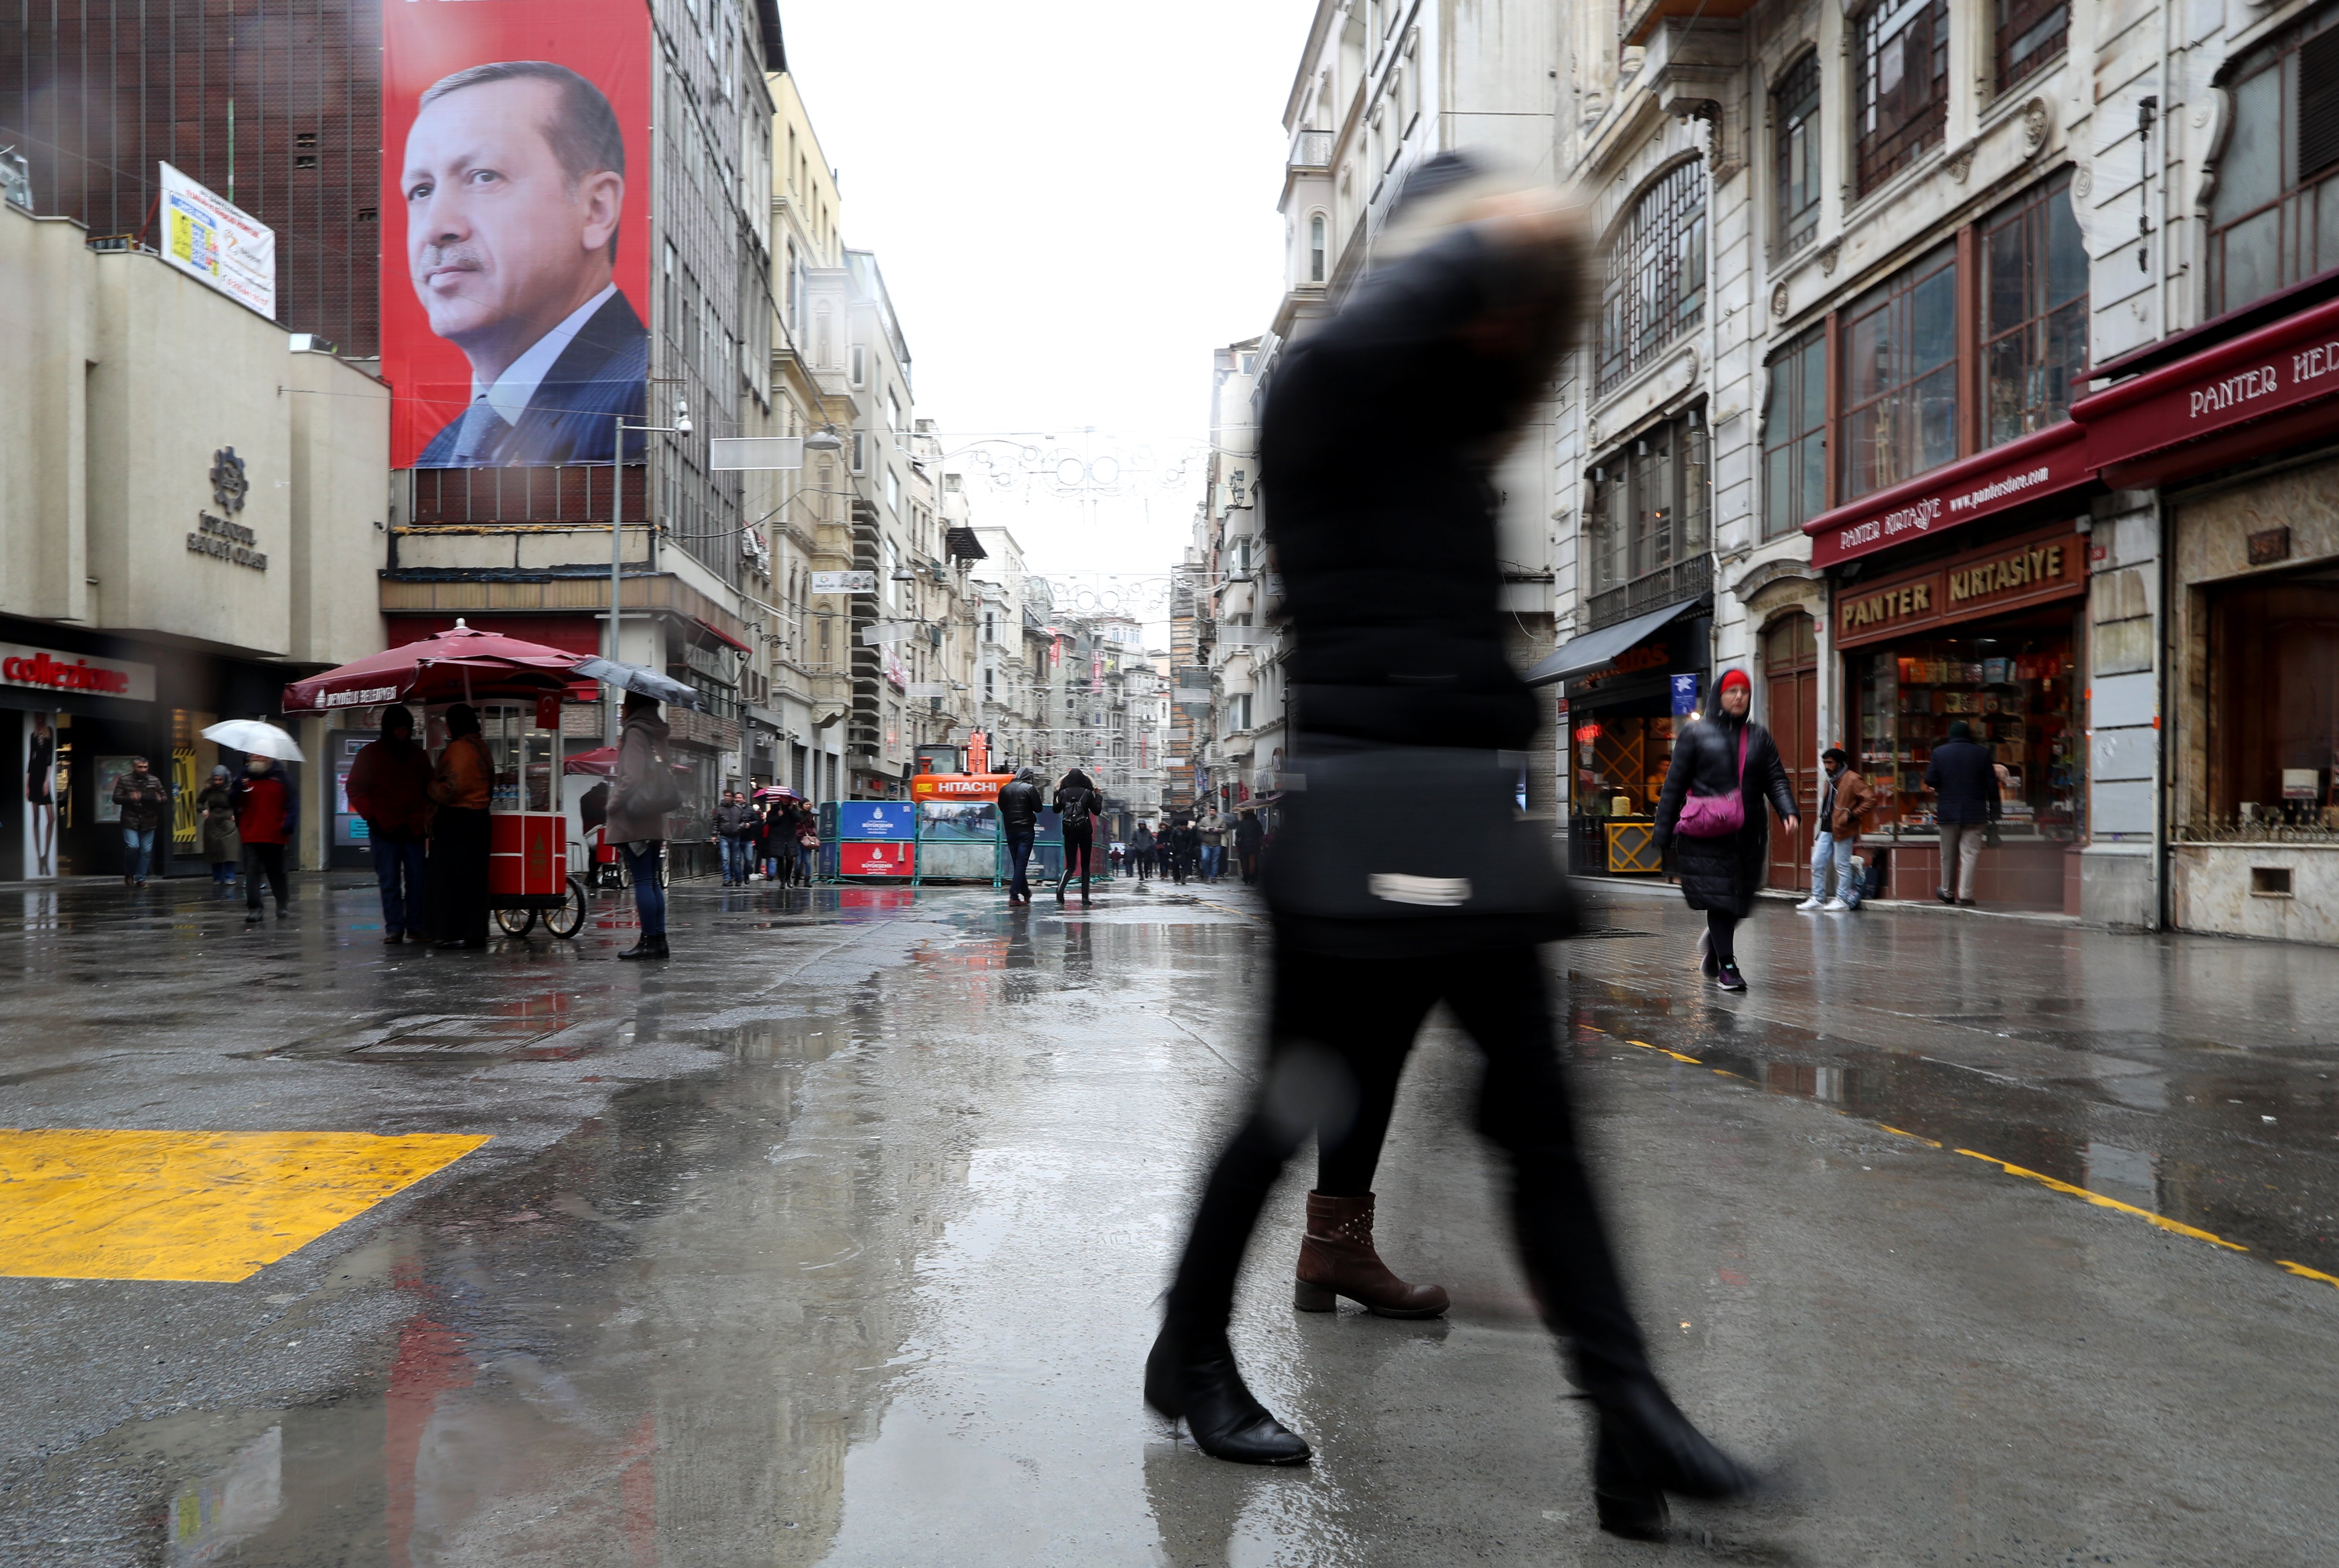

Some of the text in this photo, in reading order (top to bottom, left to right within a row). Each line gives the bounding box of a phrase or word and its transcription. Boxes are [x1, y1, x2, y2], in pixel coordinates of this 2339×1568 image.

[2190, 365, 2277, 418] PANTER
[1840, 466, 2049, 550] PANTER KIRTASİYE www.panterstore.com
[1841, 584, 1931, 629] PANTER
[1950, 544, 2063, 602] KIRTASİYE
[3, 653, 129, 693] collezione
[326, 686, 397, 706] BEYOĞLU BELEDİYESİ
[938, 782, 997, 792] HITACHI
